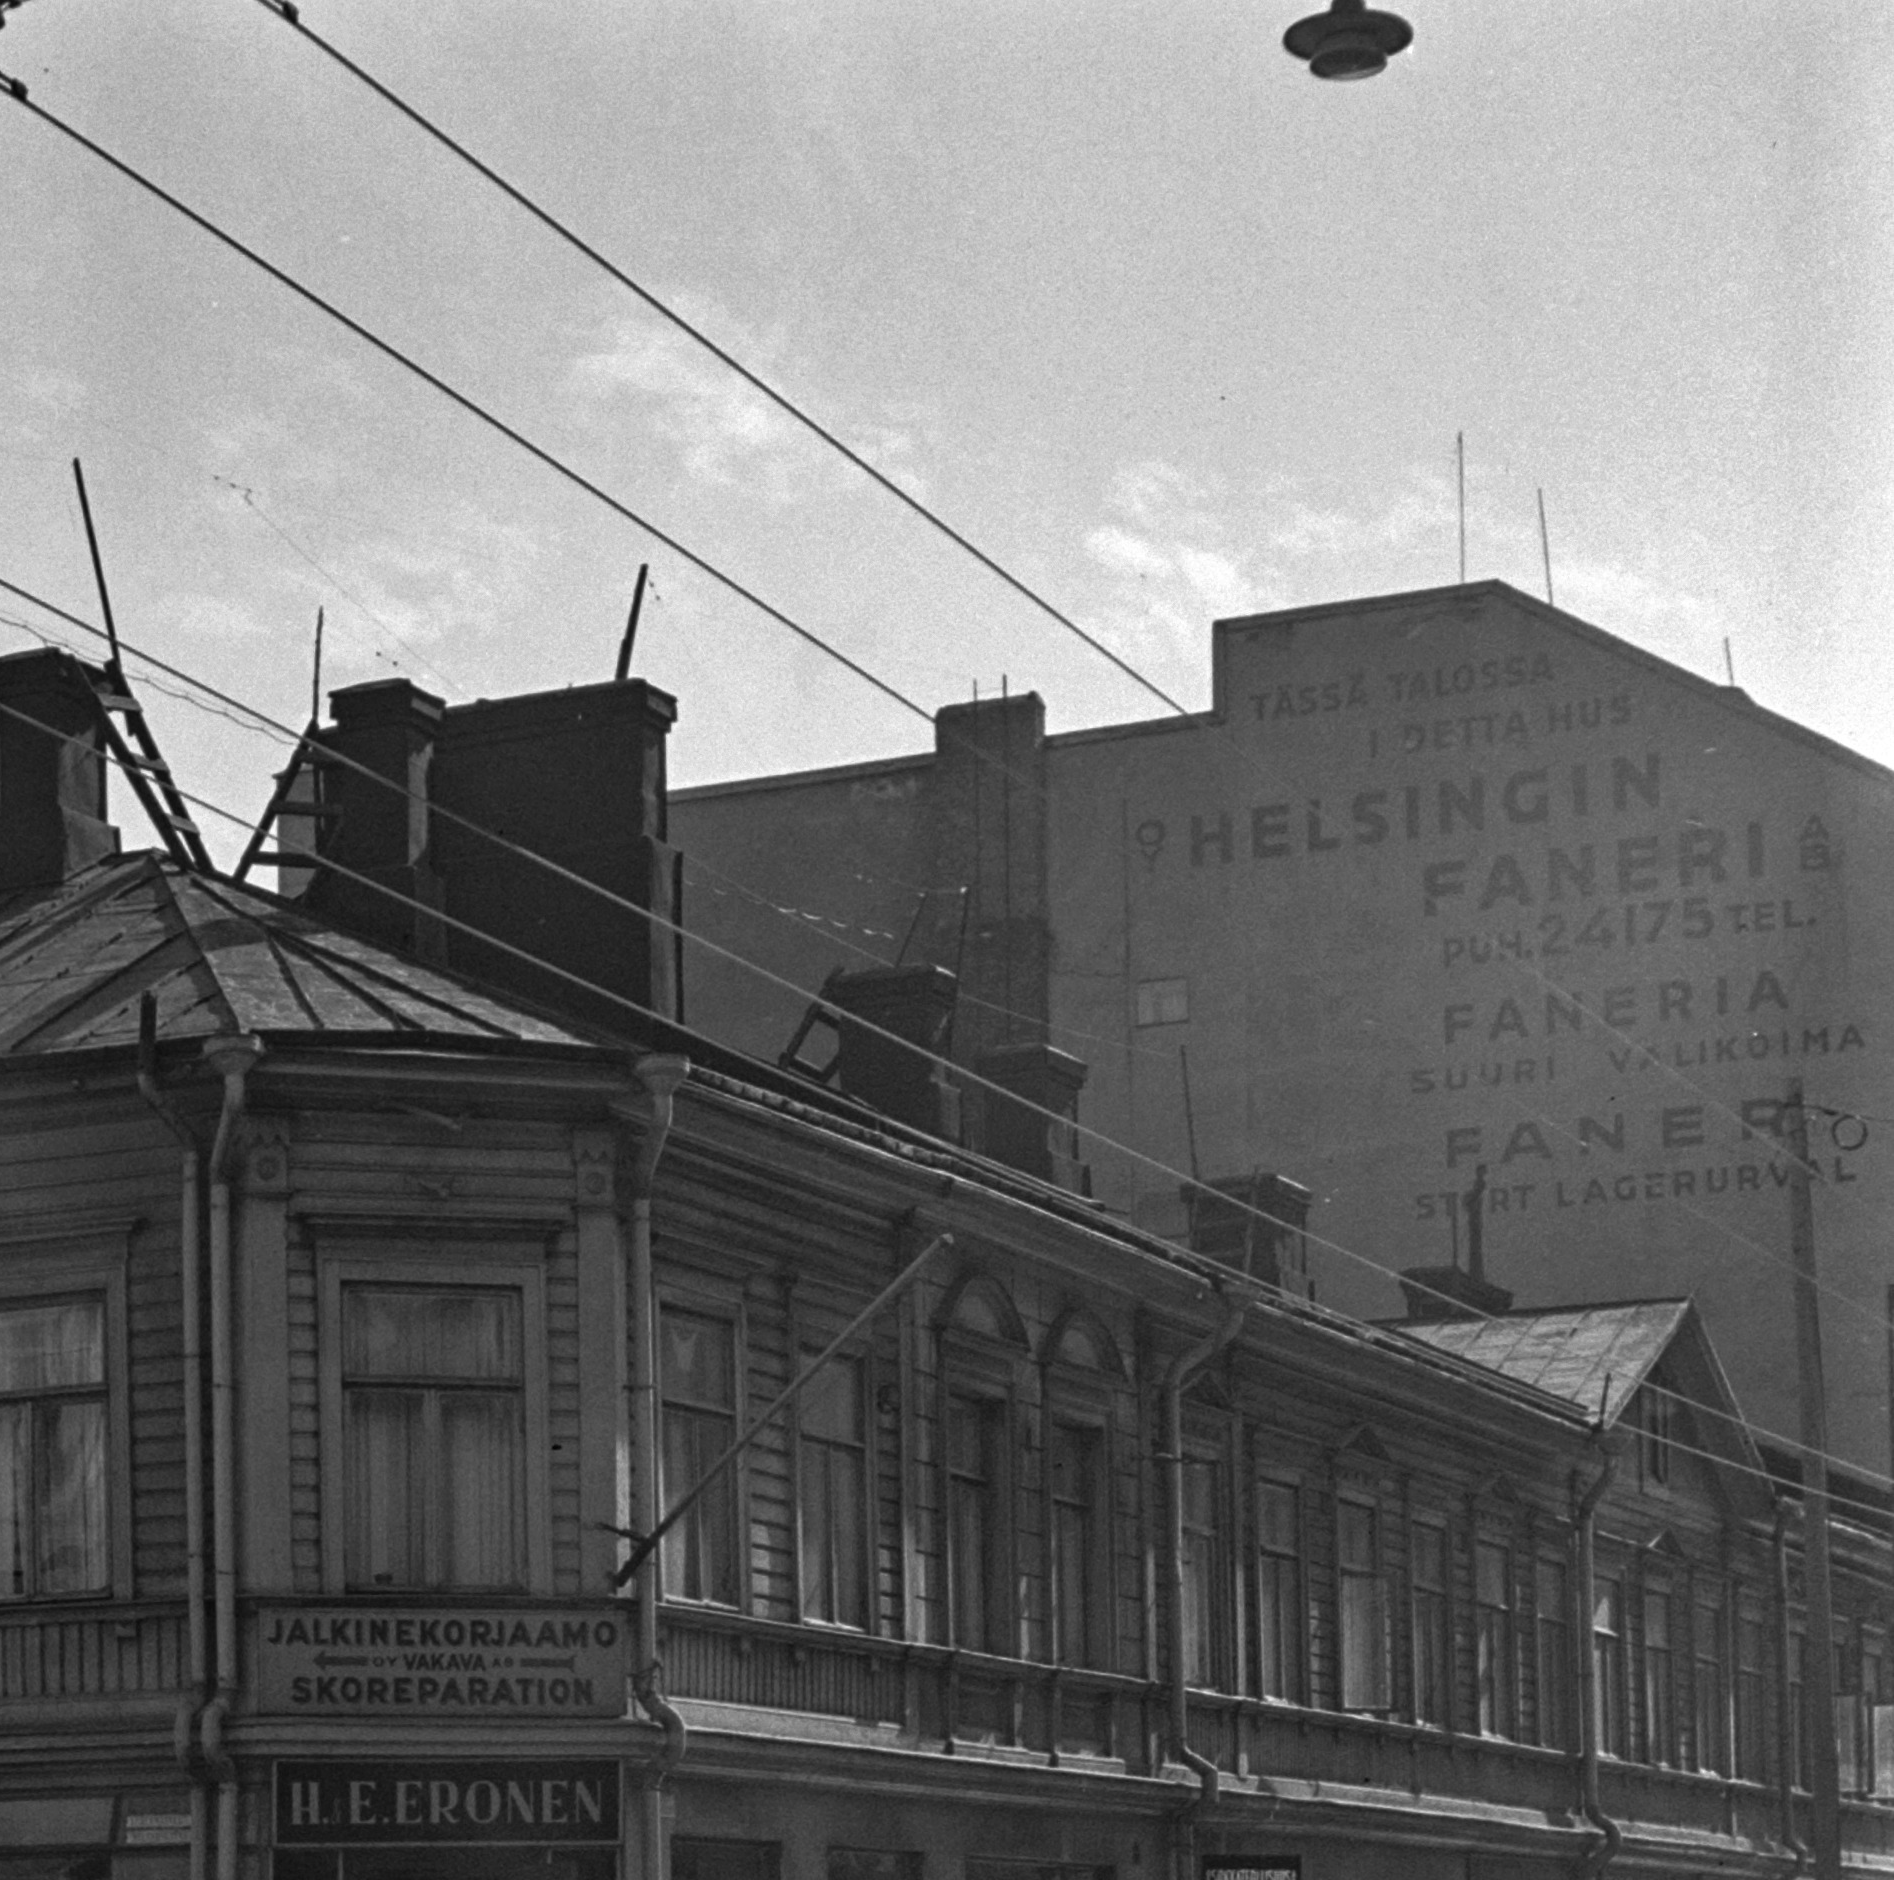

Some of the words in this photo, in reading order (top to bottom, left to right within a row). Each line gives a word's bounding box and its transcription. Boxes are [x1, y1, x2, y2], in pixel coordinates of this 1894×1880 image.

[1387, 652, 1555, 703] TALOSSA
[1368, 729, 1378, 759] I
[1402, 711, 1528, 755] DETTA
[1546, 694, 1632, 734] HUS
[1188, 752, 1661, 868] HELSINGIN
[1423, 820, 1765, 917] FANERI
[1536, 897, 1715, 956] 24175
[1725, 899, 1817, 934] TEL.
[1442, 970, 1789, 1044] FANERIA
[1411, 1055, 1556, 1094] SUURI
[1608, 1023, 1866, 1073] VALIKOIMA
[1445, 1098, 1785, 1168] FANER
[267, 1618, 619, 1649] JALKINEKORJAAMO
[372, 1656, 397, 1669] OY
[402, 1652, 487, 1672] VAKAVA
[491, 1656, 514, 1669] AB
[291, 1676, 594, 1706] SKOREPARATION
